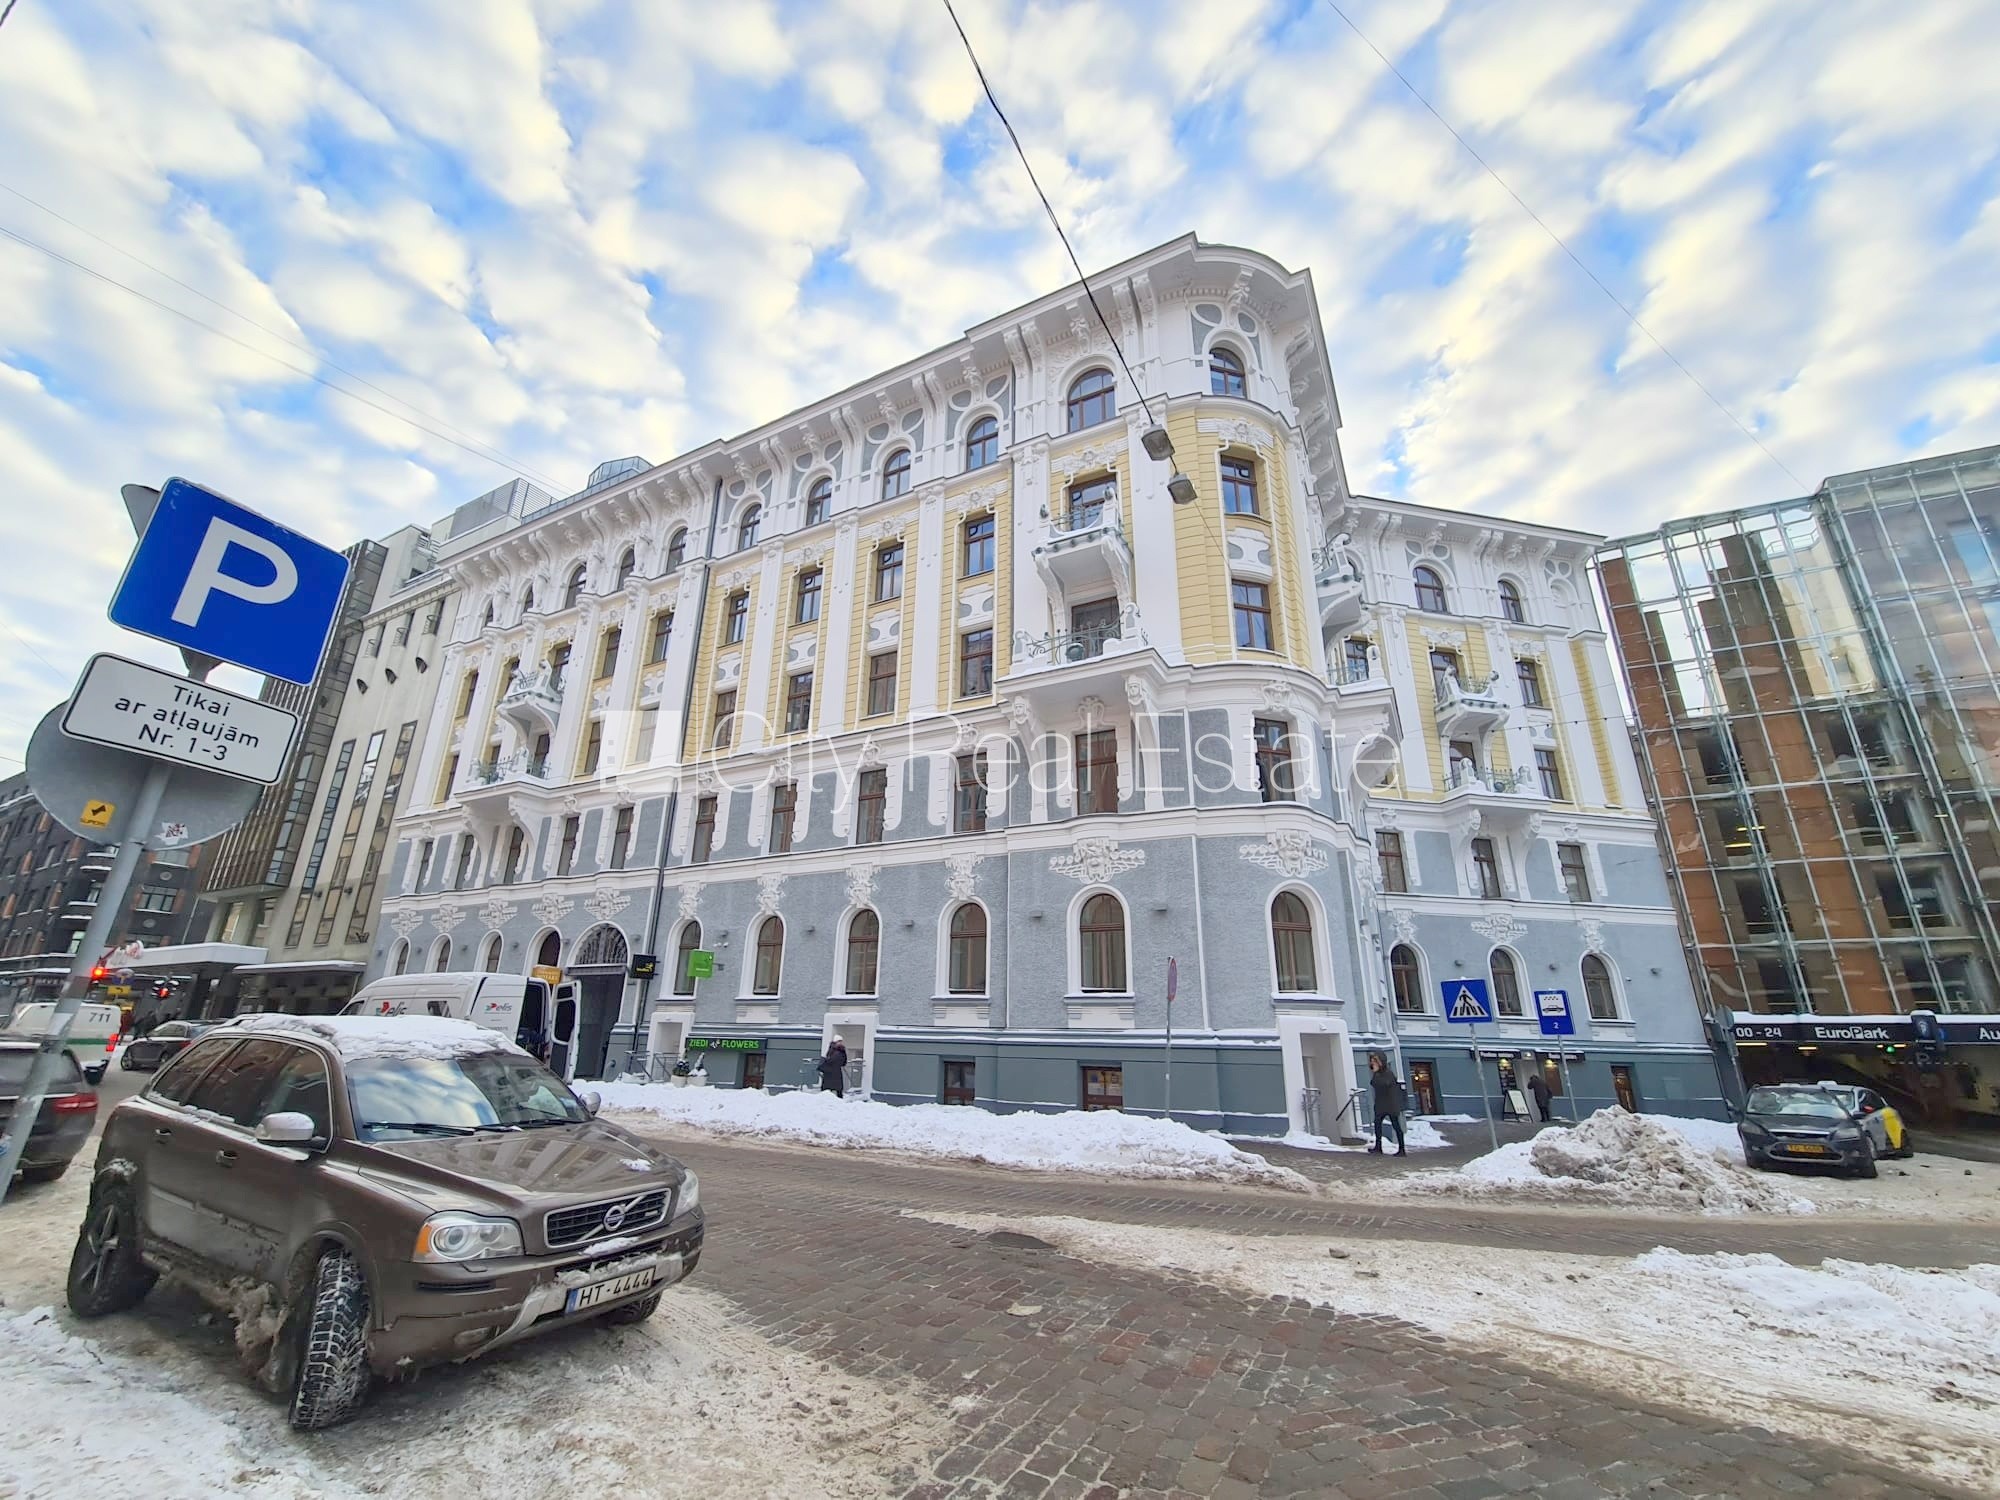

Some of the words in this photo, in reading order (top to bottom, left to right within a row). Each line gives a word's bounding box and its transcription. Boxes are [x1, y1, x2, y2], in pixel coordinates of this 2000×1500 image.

[171, 515, 299, 628] P
[174, 685, 231, 717] Tikai
[115, 697, 147, 715] ar
[153, 708, 259, 748] atļaujām
[138, 723, 174, 748] Nr.
[189, 737, 228, 761] 1-3
[88, 1011, 111, 1024] 711
[1553, 1022, 1561, 1030] 2
[1764, 1027, 1782, 1038] 24
[1815, 1026, 1890, 1039] EuroPark
[688, 1039, 709, 1048] ZIEDI
[721, 1040, 760, 1049] FLOWERS
